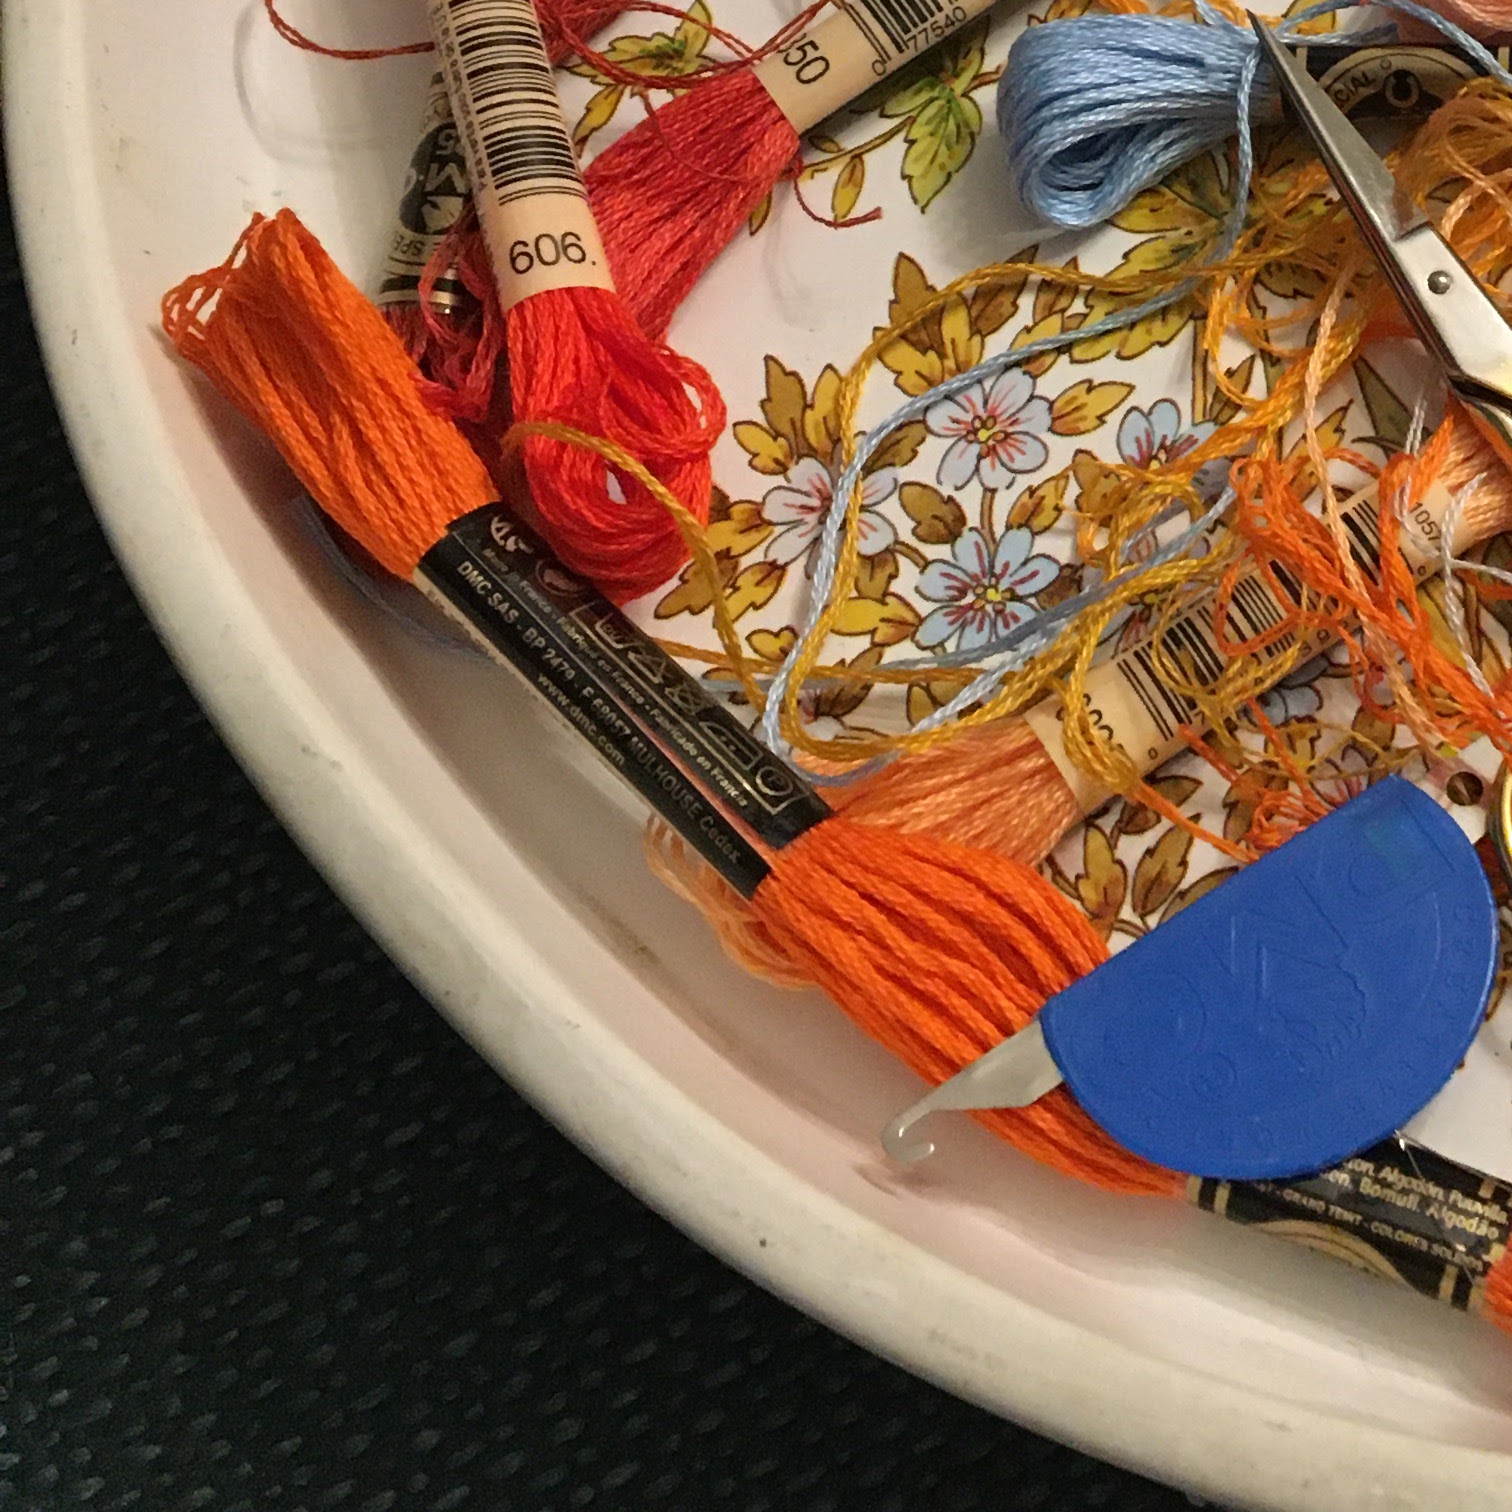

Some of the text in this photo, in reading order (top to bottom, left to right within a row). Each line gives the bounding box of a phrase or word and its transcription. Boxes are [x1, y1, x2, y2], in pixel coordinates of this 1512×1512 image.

[868, 55, 889, 78] 0
[902, 1, 970, 54] 77540
[454, 559, 493, 597] DMC
[484, 589, 522, 626] SAS
[519, 625, 548, 653] BP
[577, 684, 595, 702] F
[620, 735, 706, 820] MULHOUSE
[693, 811, 747, 865] Cedex
